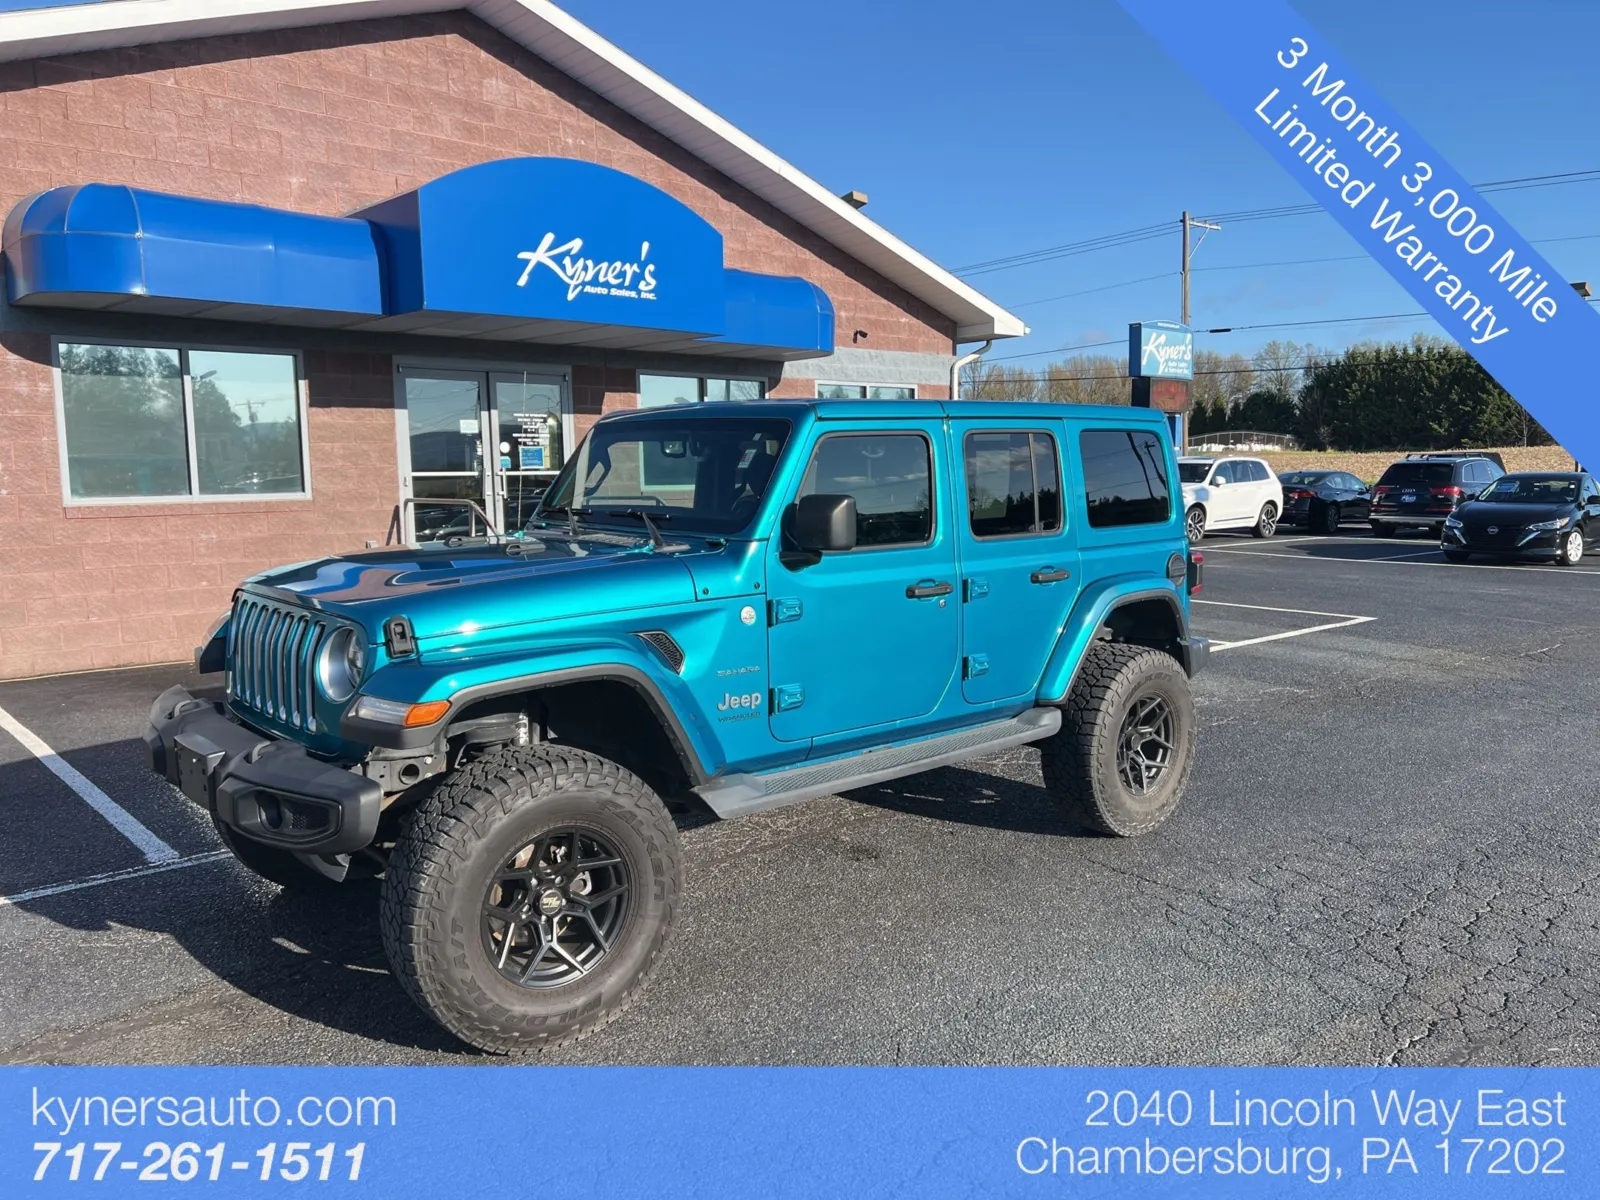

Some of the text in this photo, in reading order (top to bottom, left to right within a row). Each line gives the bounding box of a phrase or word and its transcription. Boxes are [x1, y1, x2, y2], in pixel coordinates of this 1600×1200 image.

[516, 232, 657, 302] Kyner's
[583, 285, 658, 300] Auto Sales, Inc.
[1141, 331, 1192, 375] Kyner's
[717, 692, 762, 711] Jeep
[598, 799, 667, 901] FALKEN
